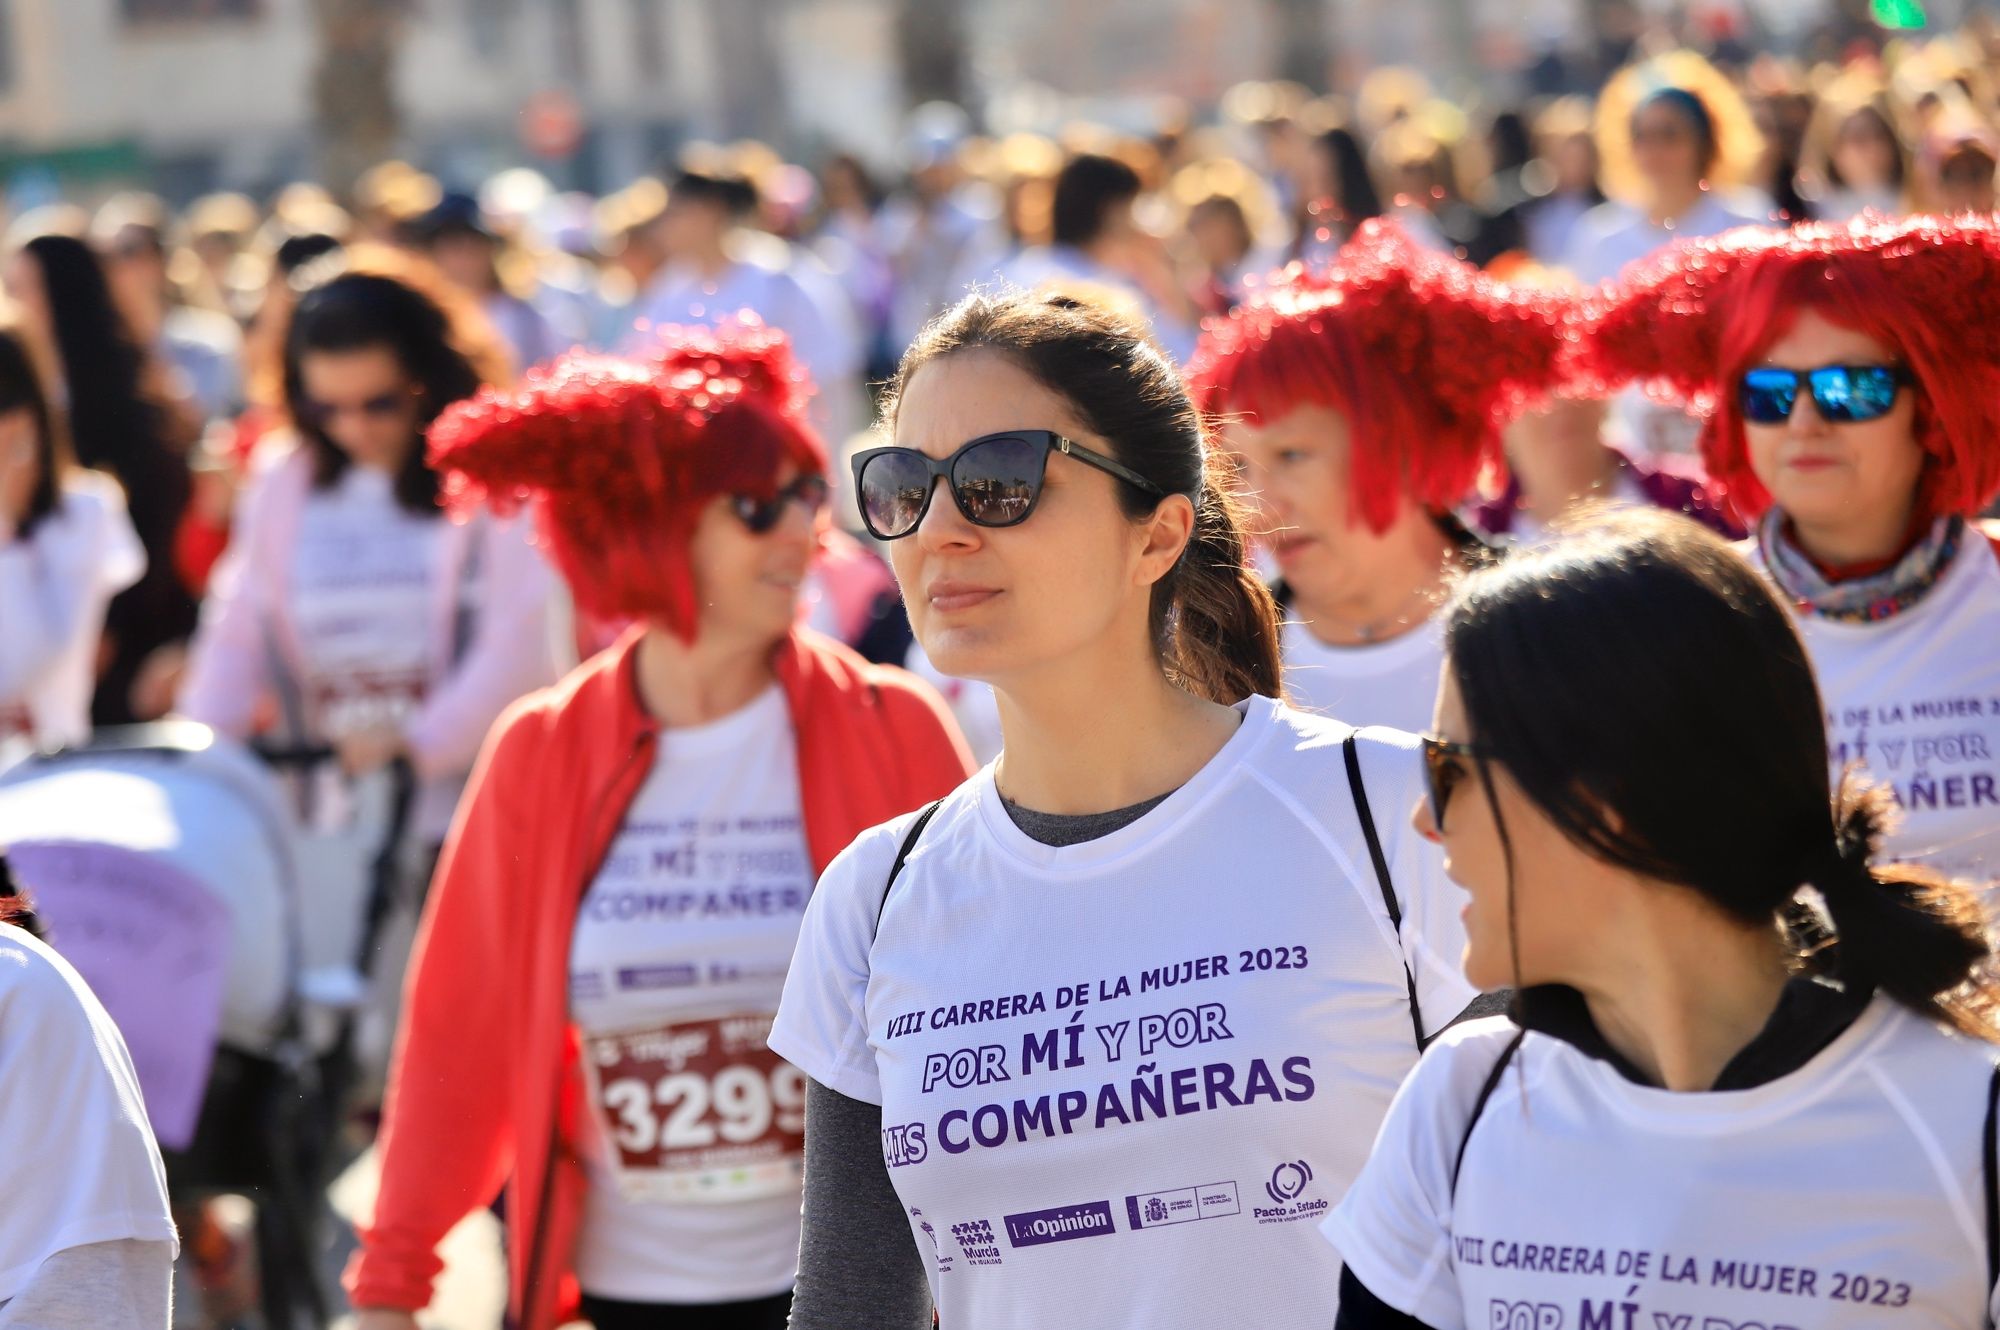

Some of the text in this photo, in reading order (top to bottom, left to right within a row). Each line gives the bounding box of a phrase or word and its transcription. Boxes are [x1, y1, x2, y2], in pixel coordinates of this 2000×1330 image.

[1843, 708, 1870, 727] DE
[1878, 704, 1904, 725] LA
[1911, 698, 1982, 721] MUJER
[1877, 739, 1907, 770] Y
[1912, 733, 1993, 768] POR
[592, 884, 803, 921] COMPAÑER
[886, 945, 1309, 1040] VIII CARRERA DE LA MUJER 2023
[921, 1002, 1235, 1093] POR MÍ Y POR
[603, 1063, 805, 1154] 3299
[882, 1055, 1315, 1168] MIS COMPAÑERAS
[1253, 1207, 1287, 1218] Pacto
[1296, 1198, 1328, 1213] Estado
[963, 1246, 1000, 1259] Murcia
[1455, 1236, 1912, 1308] VIII CARRERA DE LA MUJER 2023
[1489, 1298, 1564, 1330] POR
[1579, 1284, 1640, 1330] MÍ
